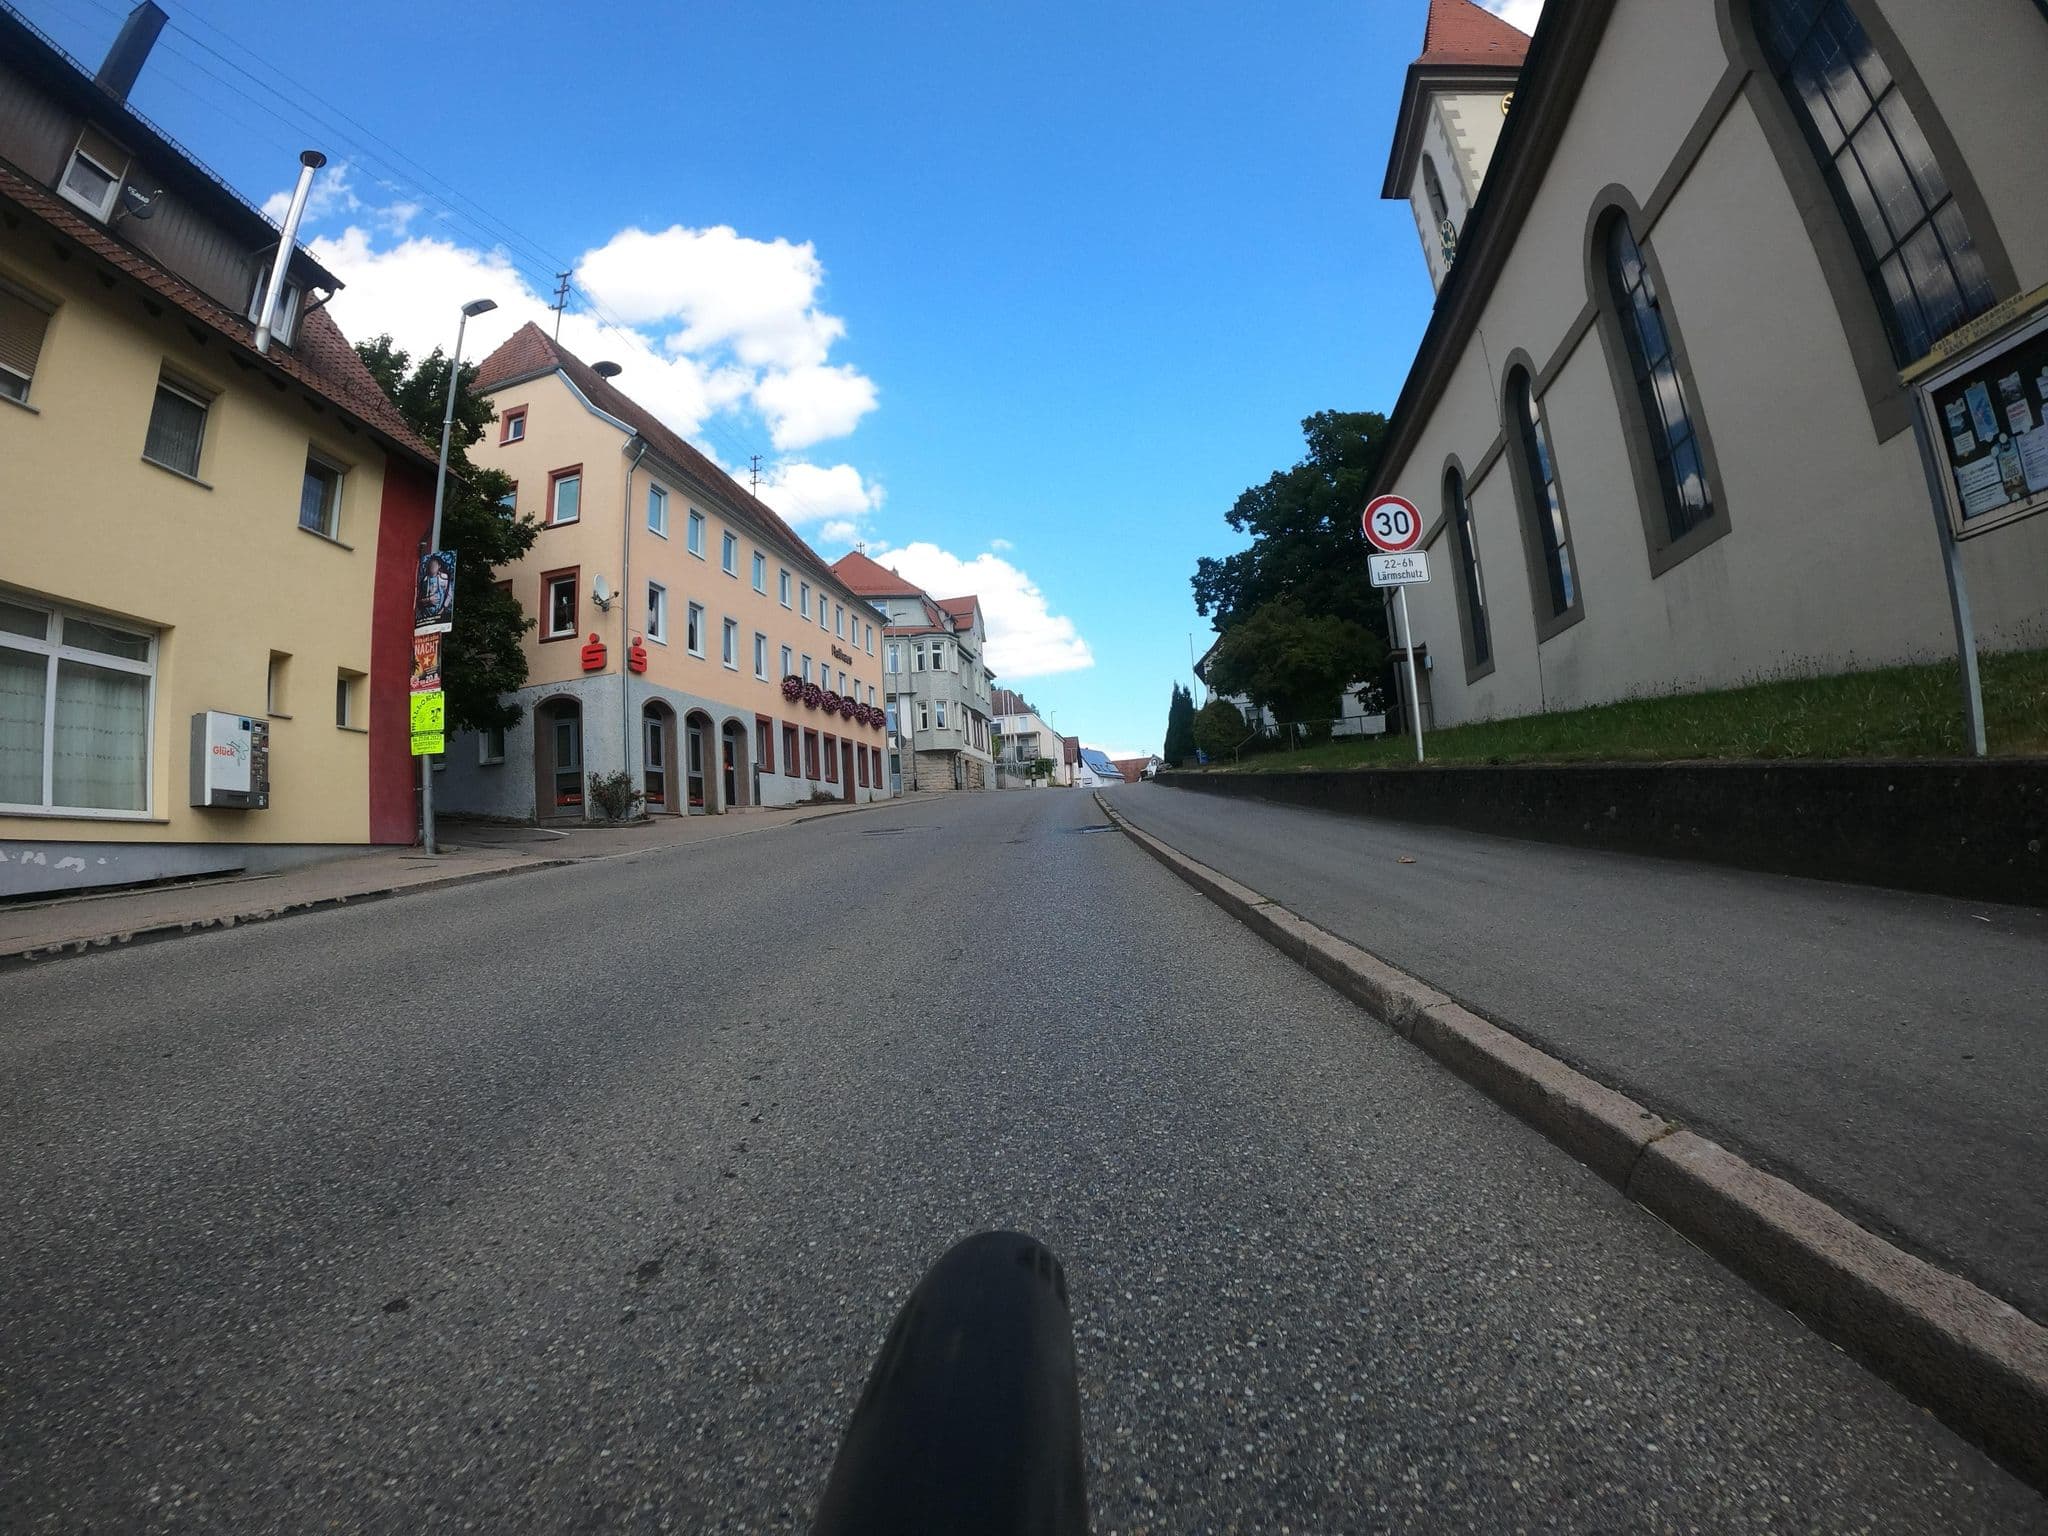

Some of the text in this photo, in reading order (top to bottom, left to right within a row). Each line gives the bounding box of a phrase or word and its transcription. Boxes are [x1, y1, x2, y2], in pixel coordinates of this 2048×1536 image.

[1376, 510, 1410, 537] 30
[1377, 570, 1423, 581] Lärmschutz
[414, 639, 440, 657] NACHT
[212, 744, 236, 758] Glück
